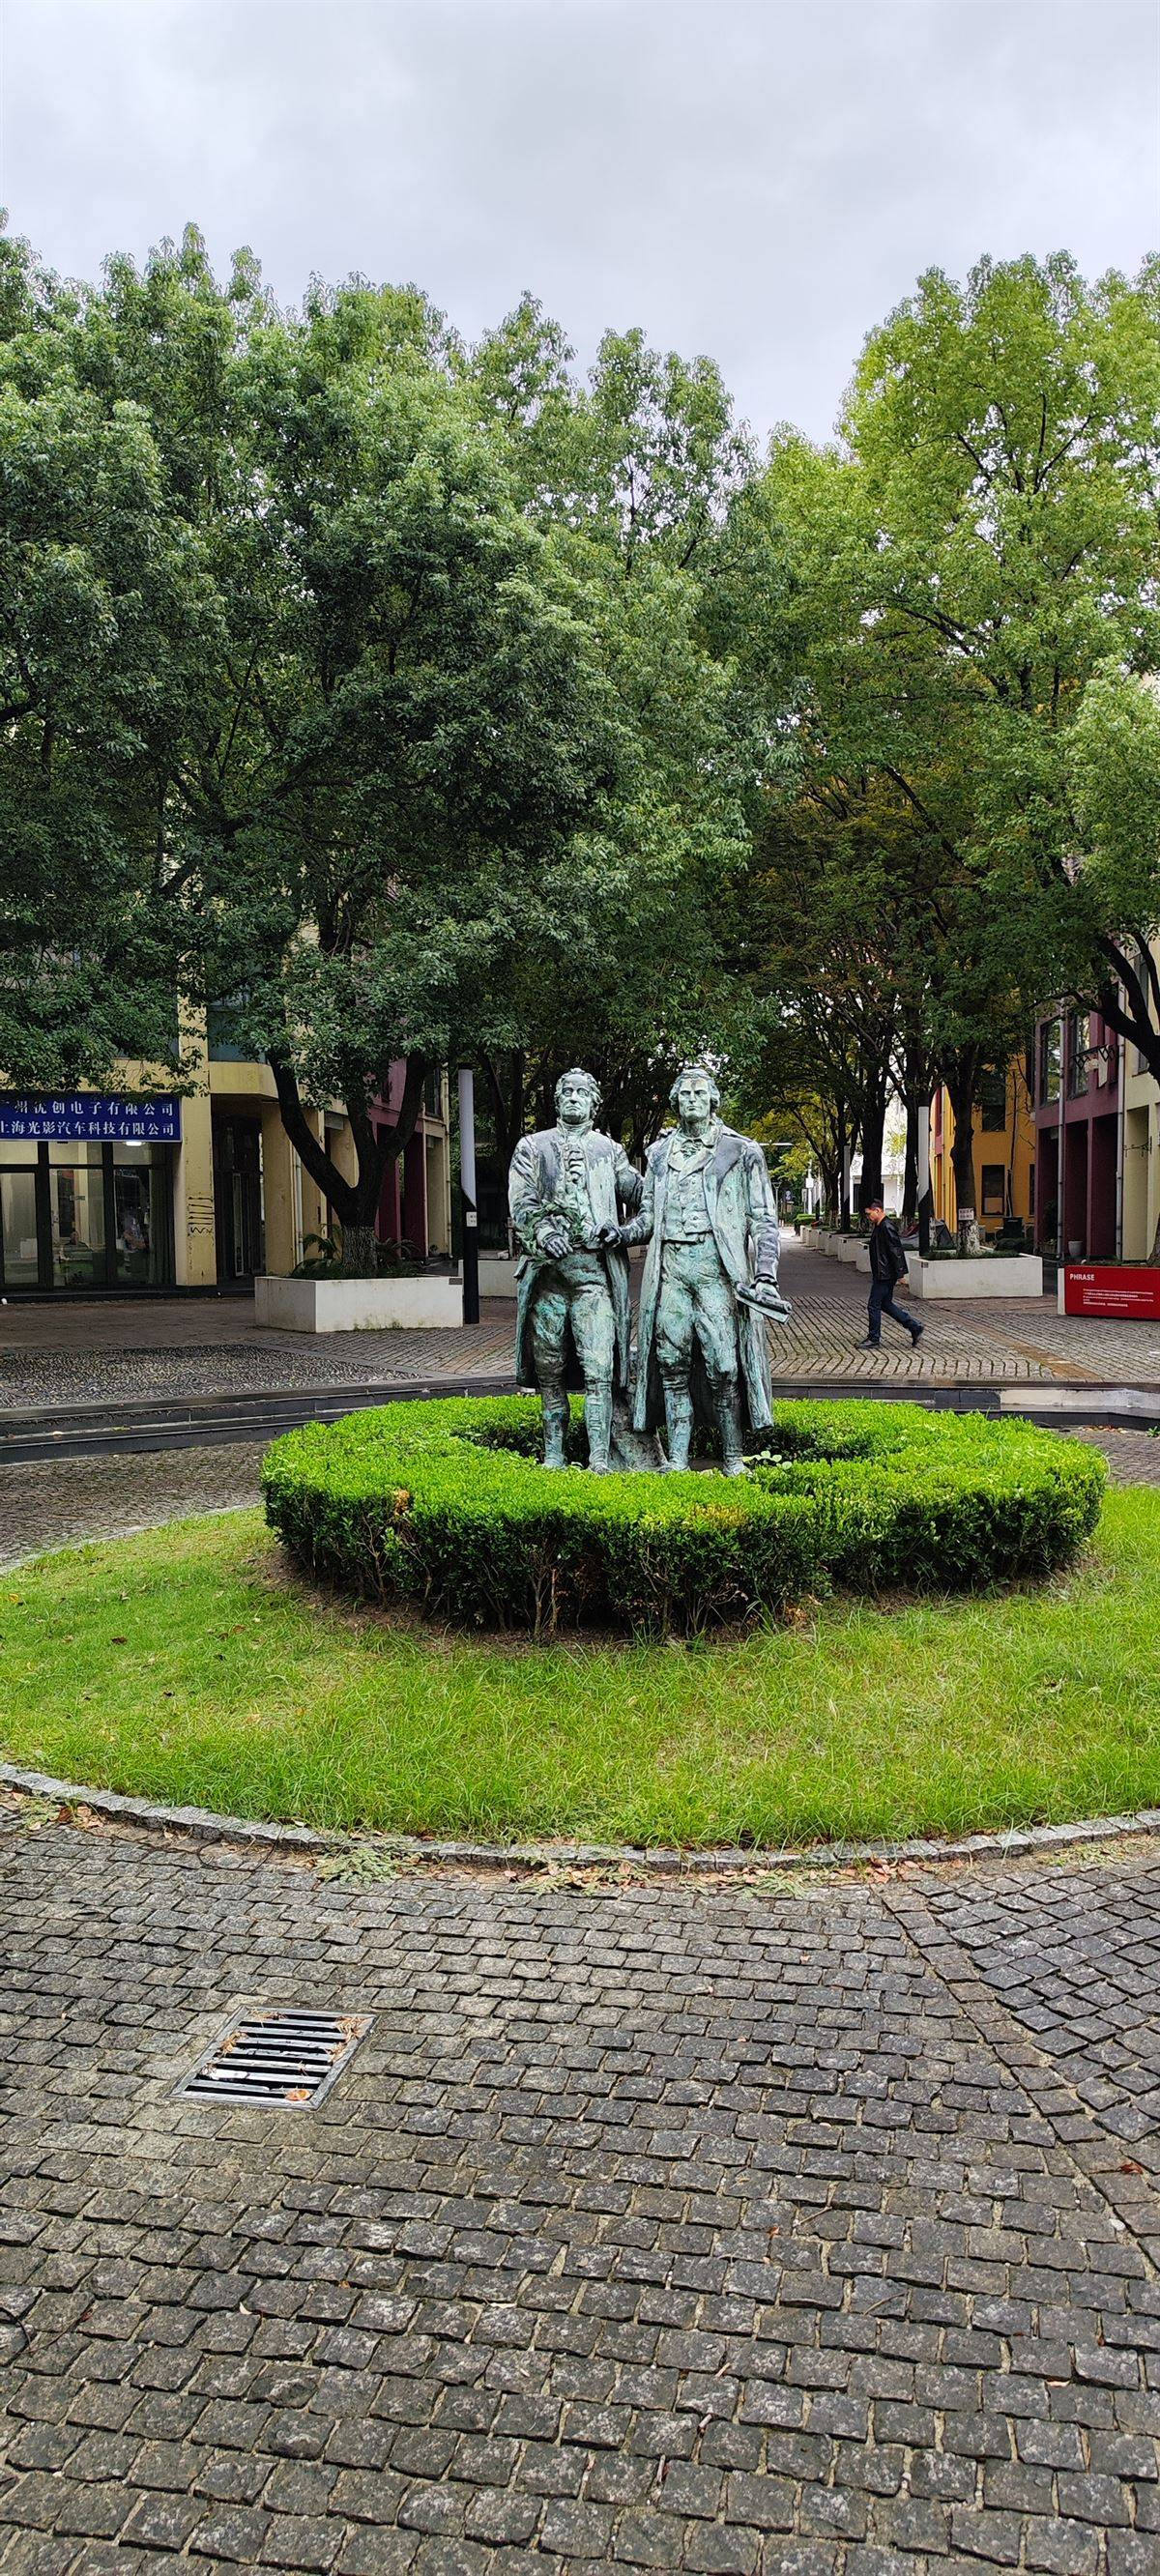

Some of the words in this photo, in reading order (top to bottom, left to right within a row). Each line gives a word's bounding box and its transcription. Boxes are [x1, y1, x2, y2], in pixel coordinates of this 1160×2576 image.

[0, 1099, 174, 1116] 州优创电子有限公司
[0, 1120, 174, 1136] 上海光影汽车科技有限公司
[1069, 1273, 1095, 1282] PHRASE
